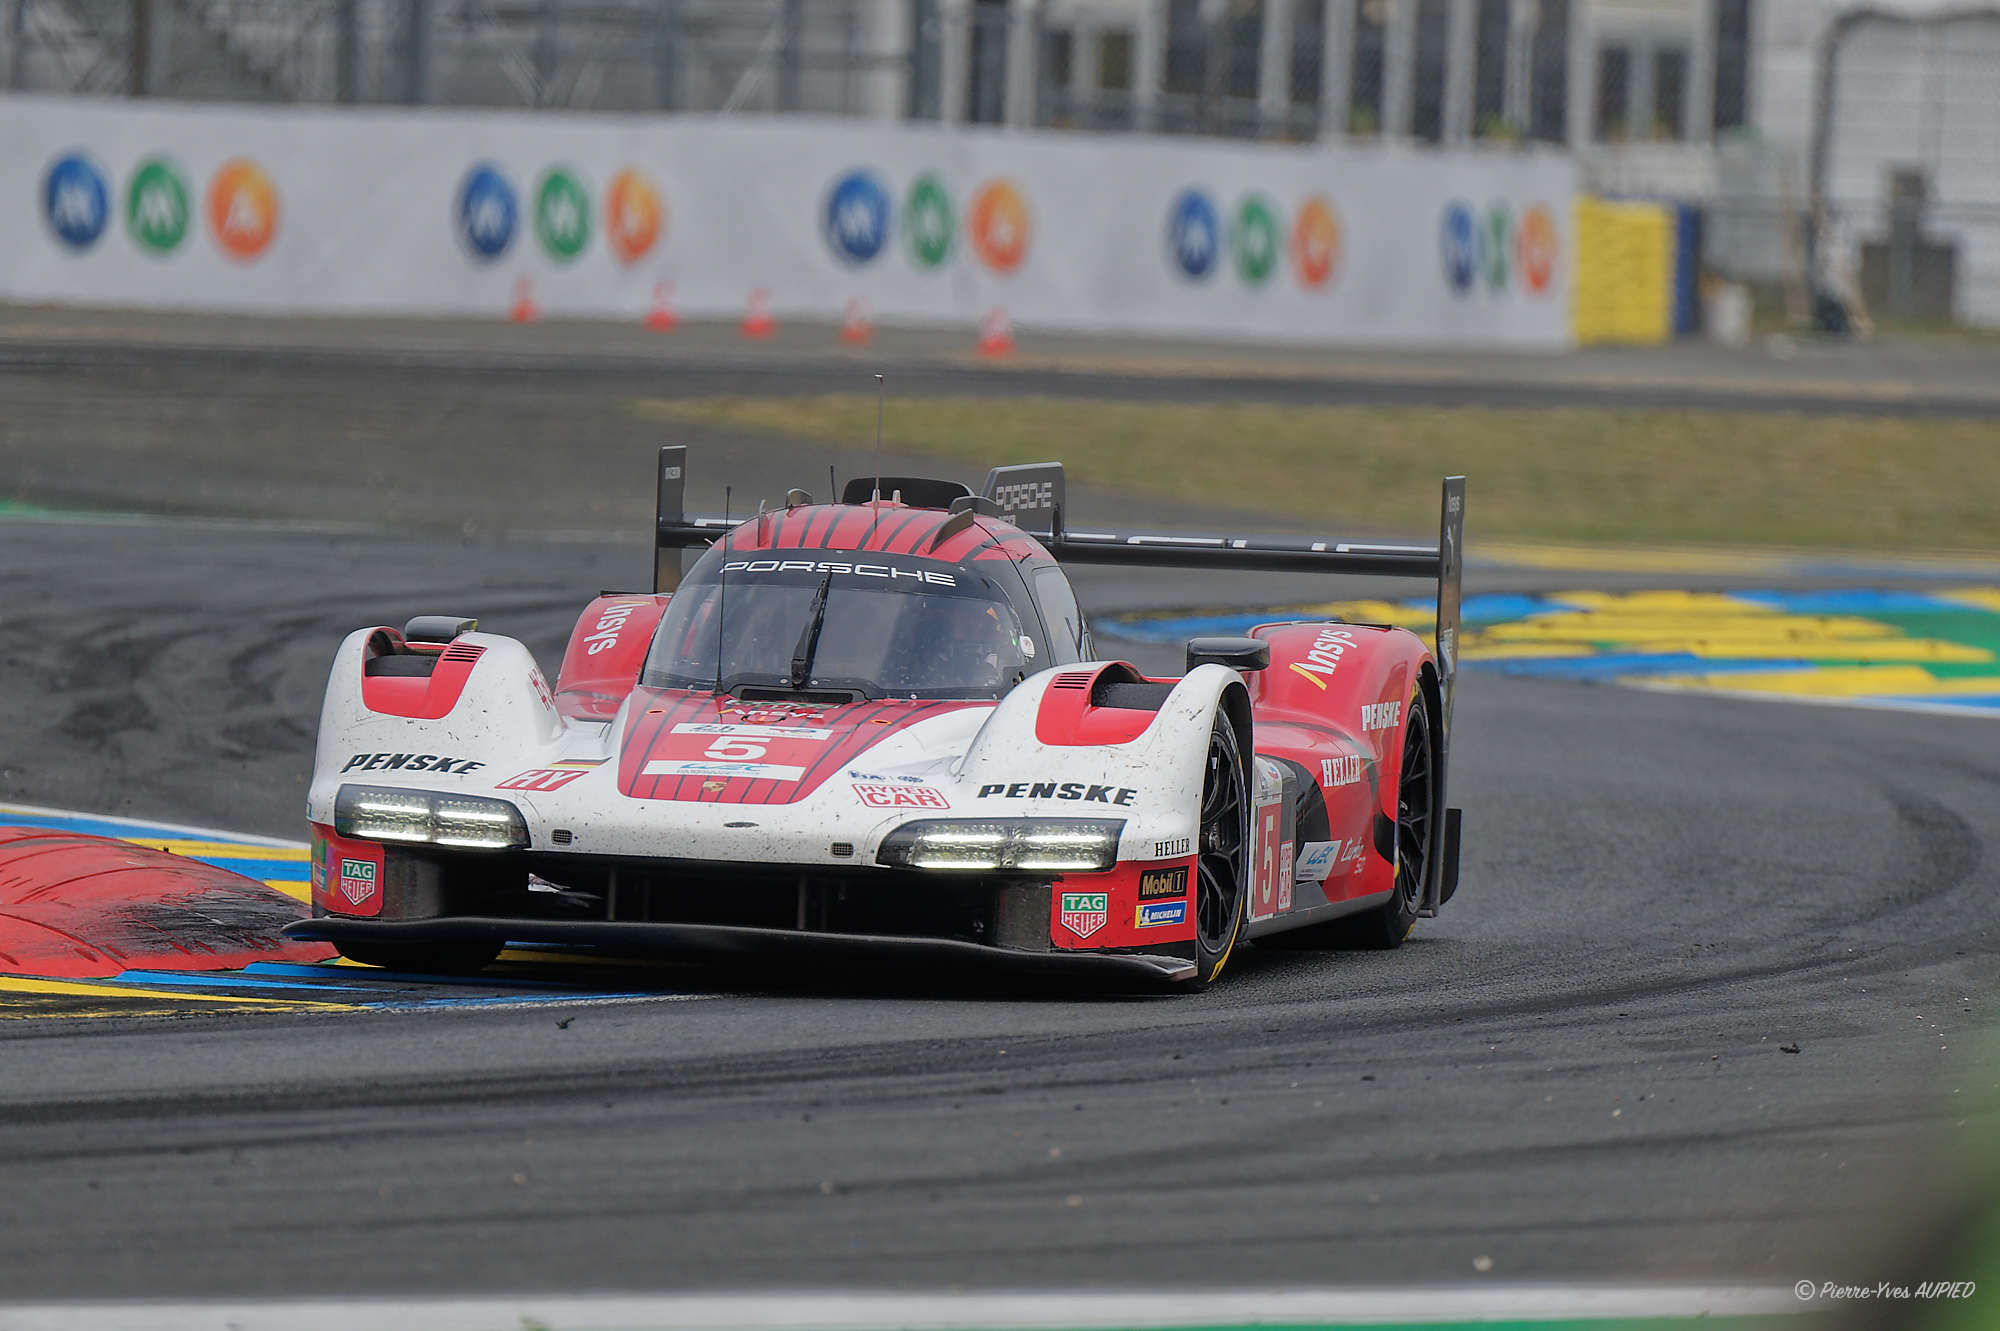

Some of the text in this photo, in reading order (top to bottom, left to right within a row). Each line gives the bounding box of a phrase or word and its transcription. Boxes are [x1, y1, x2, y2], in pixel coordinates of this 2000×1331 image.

[720, 561, 957, 587] PORSCHE
[583, 599, 652, 656] Ansys
[1289, 629, 1358, 690] Ansys
[1361, 700, 1402, 732] PENSKE
[704, 736, 772, 760] 5
[341, 753, 486, 774] PENSKE
[1320, 755, 1361, 788] HELLER
[513, 770, 576, 790] HY
[858, 785, 934, 796] HYPER
[865, 793, 942, 807] CAR
[977, 783, 1138, 807] PENSKE
[1155, 838, 1191, 857] HELLER
[343, 862, 373, 879] TAG
[1262, 815, 1274, 905] 5
[342, 878, 373, 901] HEUER
[1142, 872, 1174, 896] Mobil
[1066, 896, 1104, 910] TAG
[1064, 912, 1105, 933] HEUER
